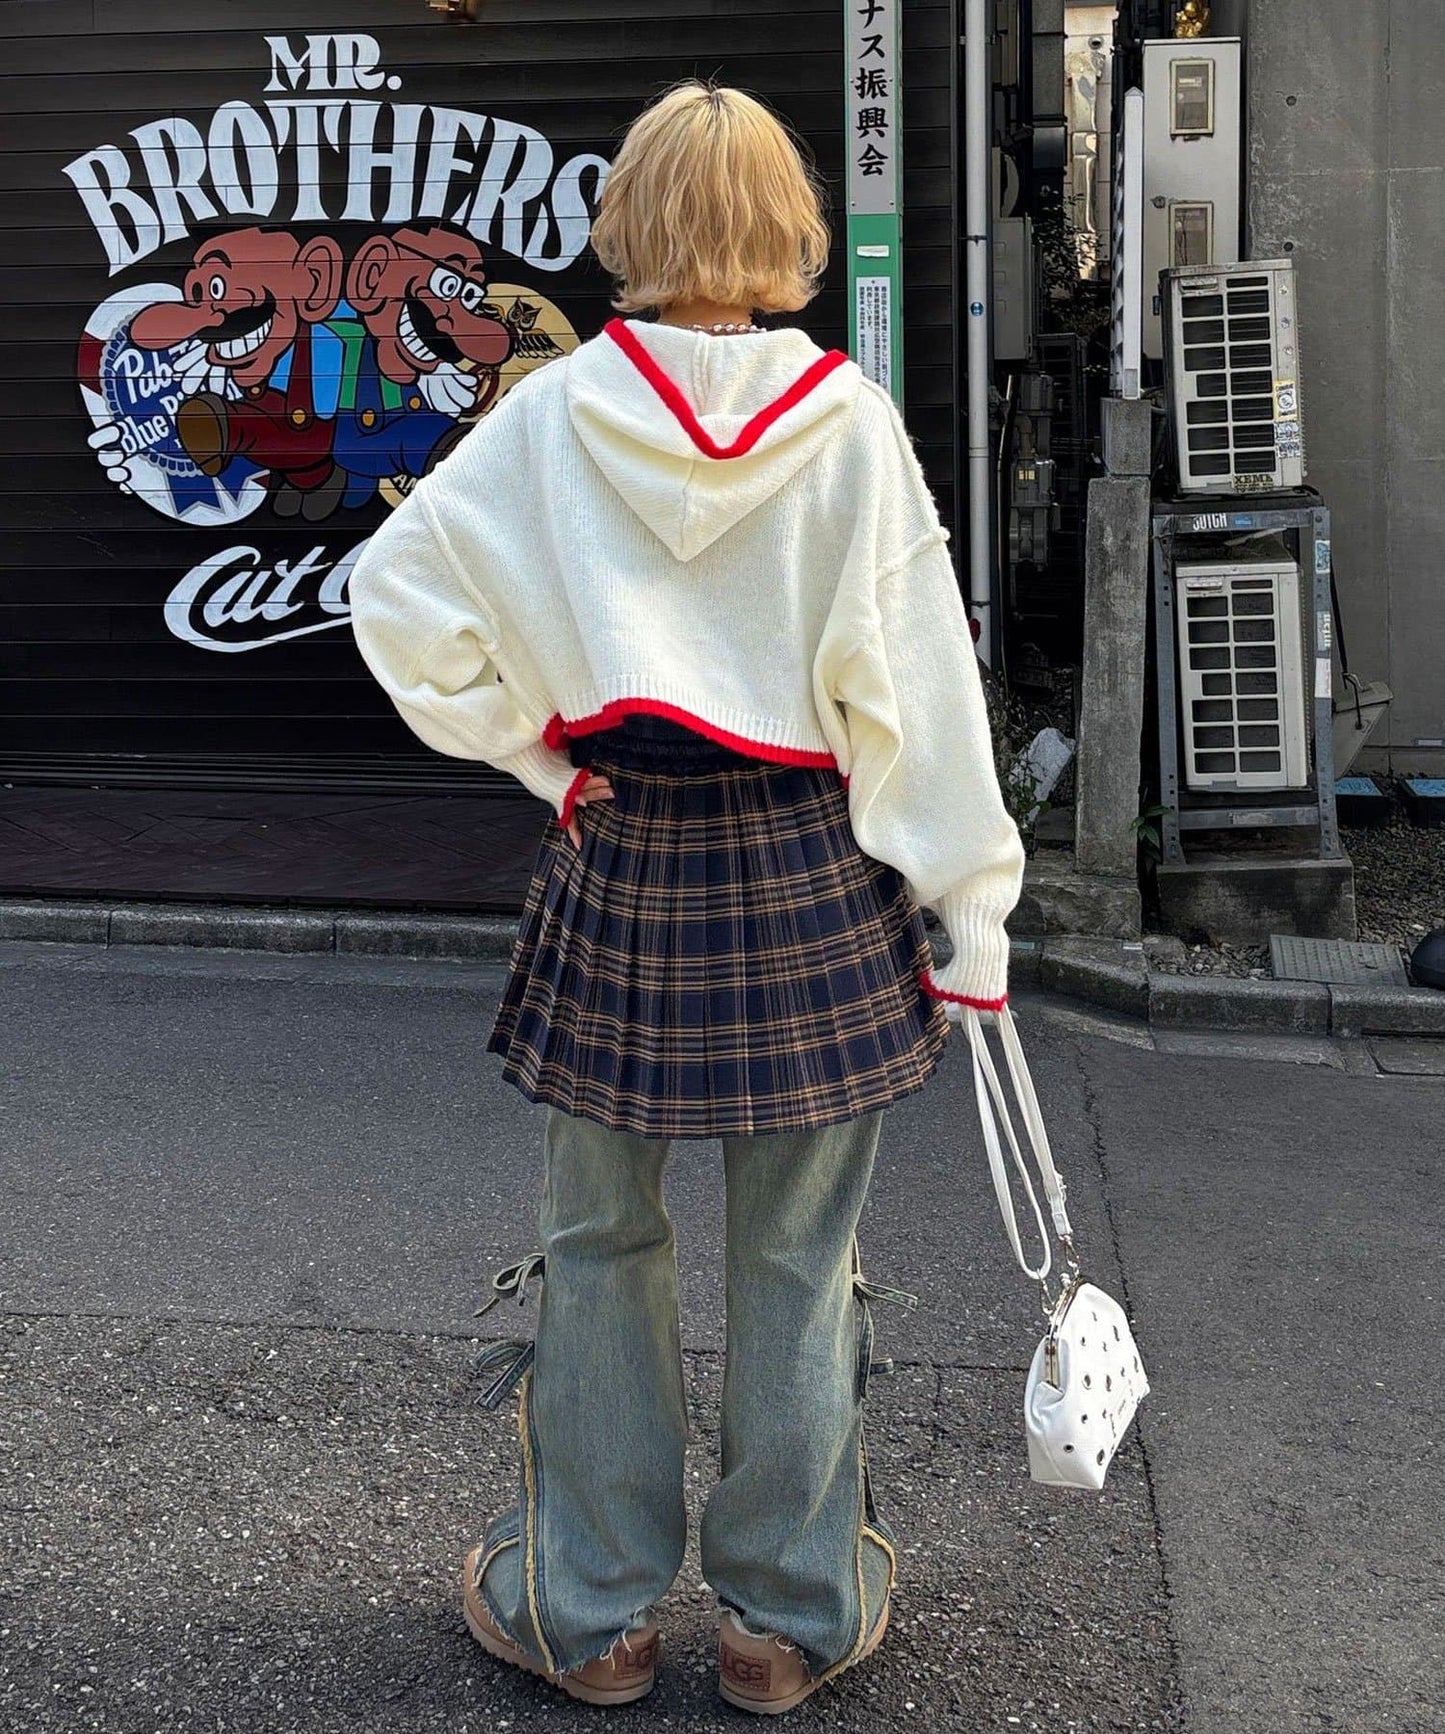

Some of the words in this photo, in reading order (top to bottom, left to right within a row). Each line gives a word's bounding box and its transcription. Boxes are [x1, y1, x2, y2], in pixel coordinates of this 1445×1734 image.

[263, 34, 402, 92] MR.
[62, 100, 613, 278] BROTHERS
[164, 546, 333, 653] Cut
